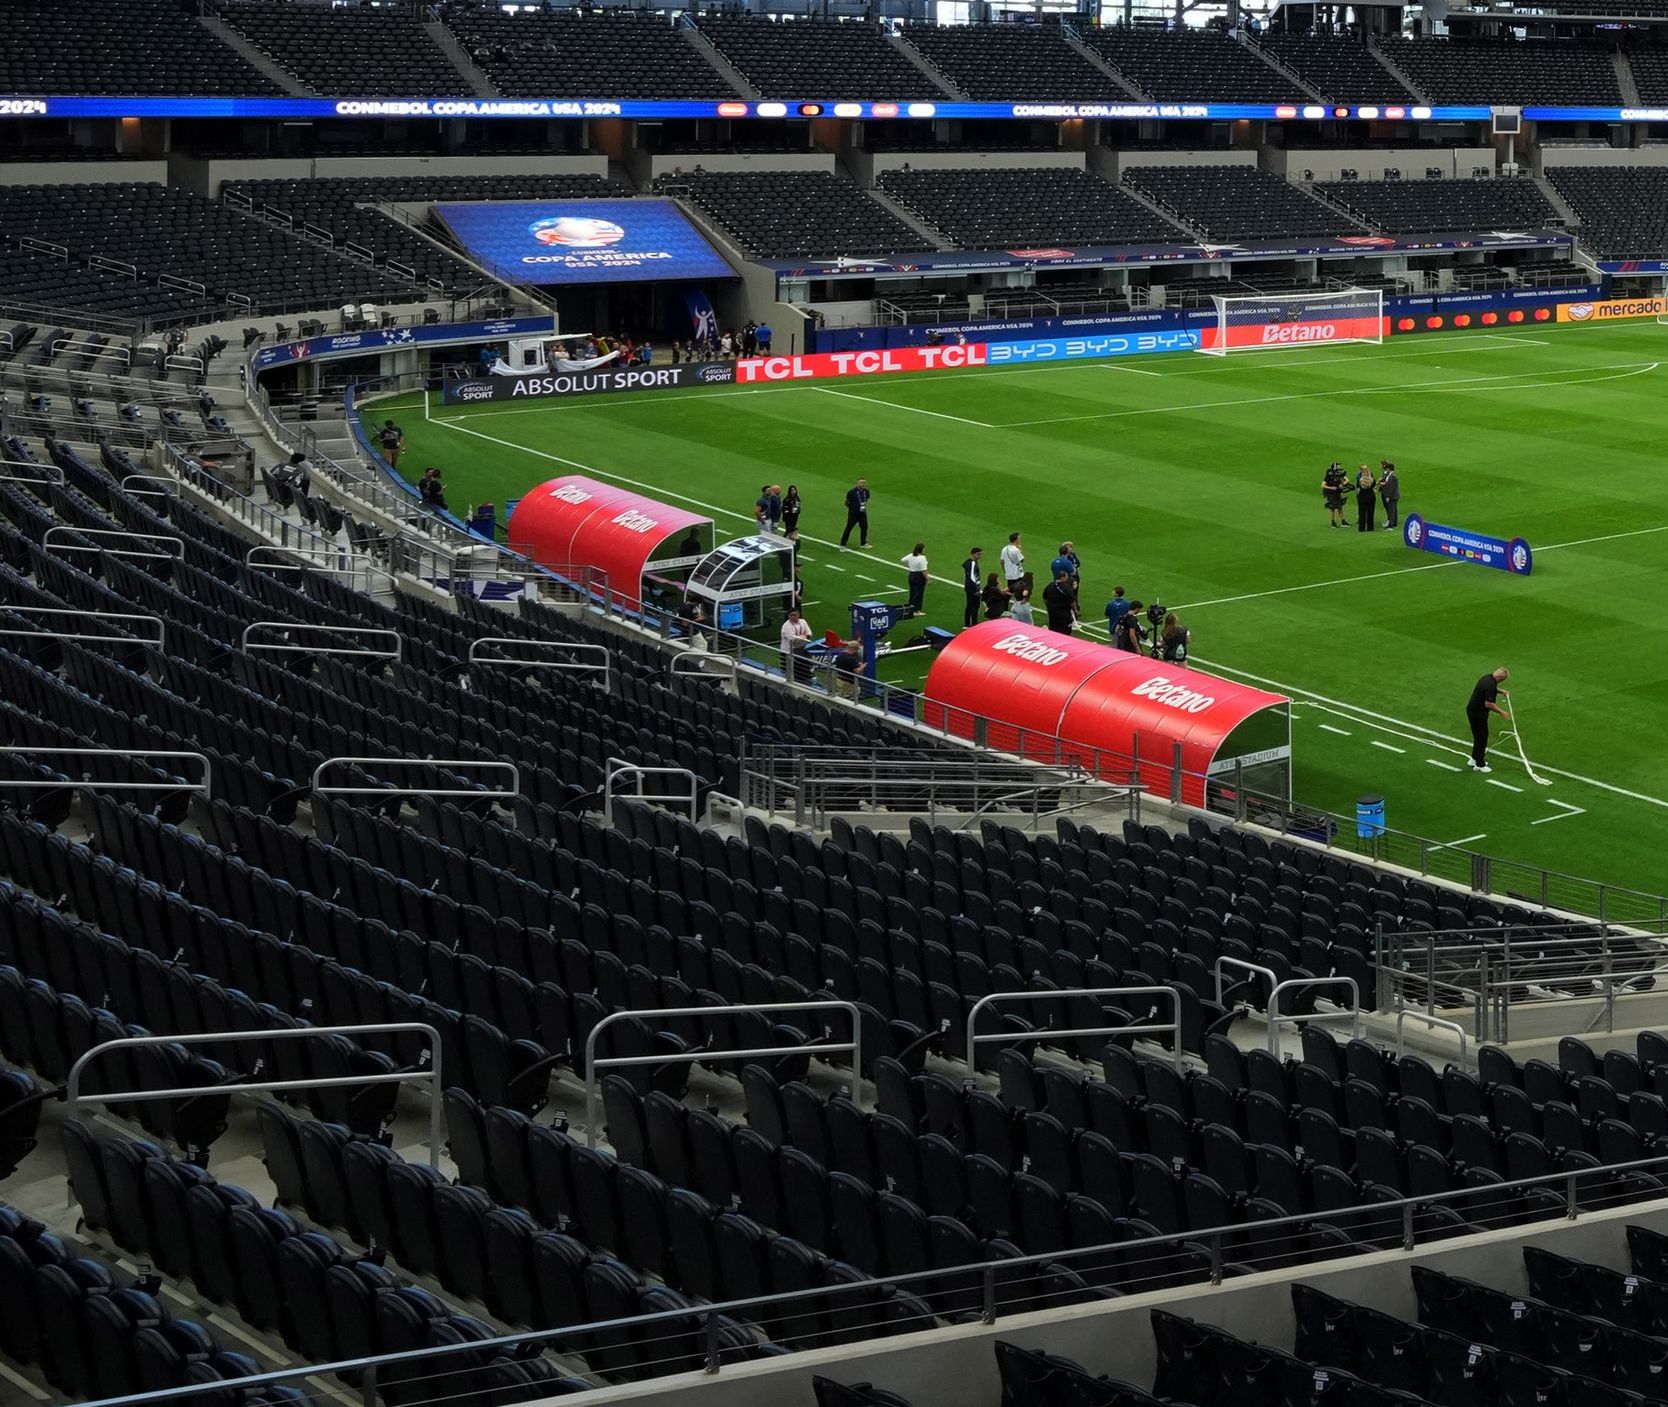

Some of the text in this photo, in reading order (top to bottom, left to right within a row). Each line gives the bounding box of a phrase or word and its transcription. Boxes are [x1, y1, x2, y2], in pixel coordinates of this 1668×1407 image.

[335, 101, 620, 115] CONMEBOL COPA AMERICA USA 2024
[1599, 301, 1661, 317] mercado
[1262, 323, 1336, 343] Betano
[991, 333, 1198, 361] BYD BYD BYD
[705, 367, 733, 376] ABSOLUT
[737, 346, 986, 382] TCL TCL TCL
[513, 368, 683, 397] ABSOLUT SPORT
[705, 373, 732, 383] SPORT
[463, 384, 494, 393] ABSOLUT
[463, 392, 494, 401] SPORT
[550, 485, 593, 505] Betano
[612, 509, 659, 533] Betano
[992, 634, 1068, 666] Betano
[1131, 677, 1215, 714] Betano
[1241, 749, 1279, 765] STADIUM
